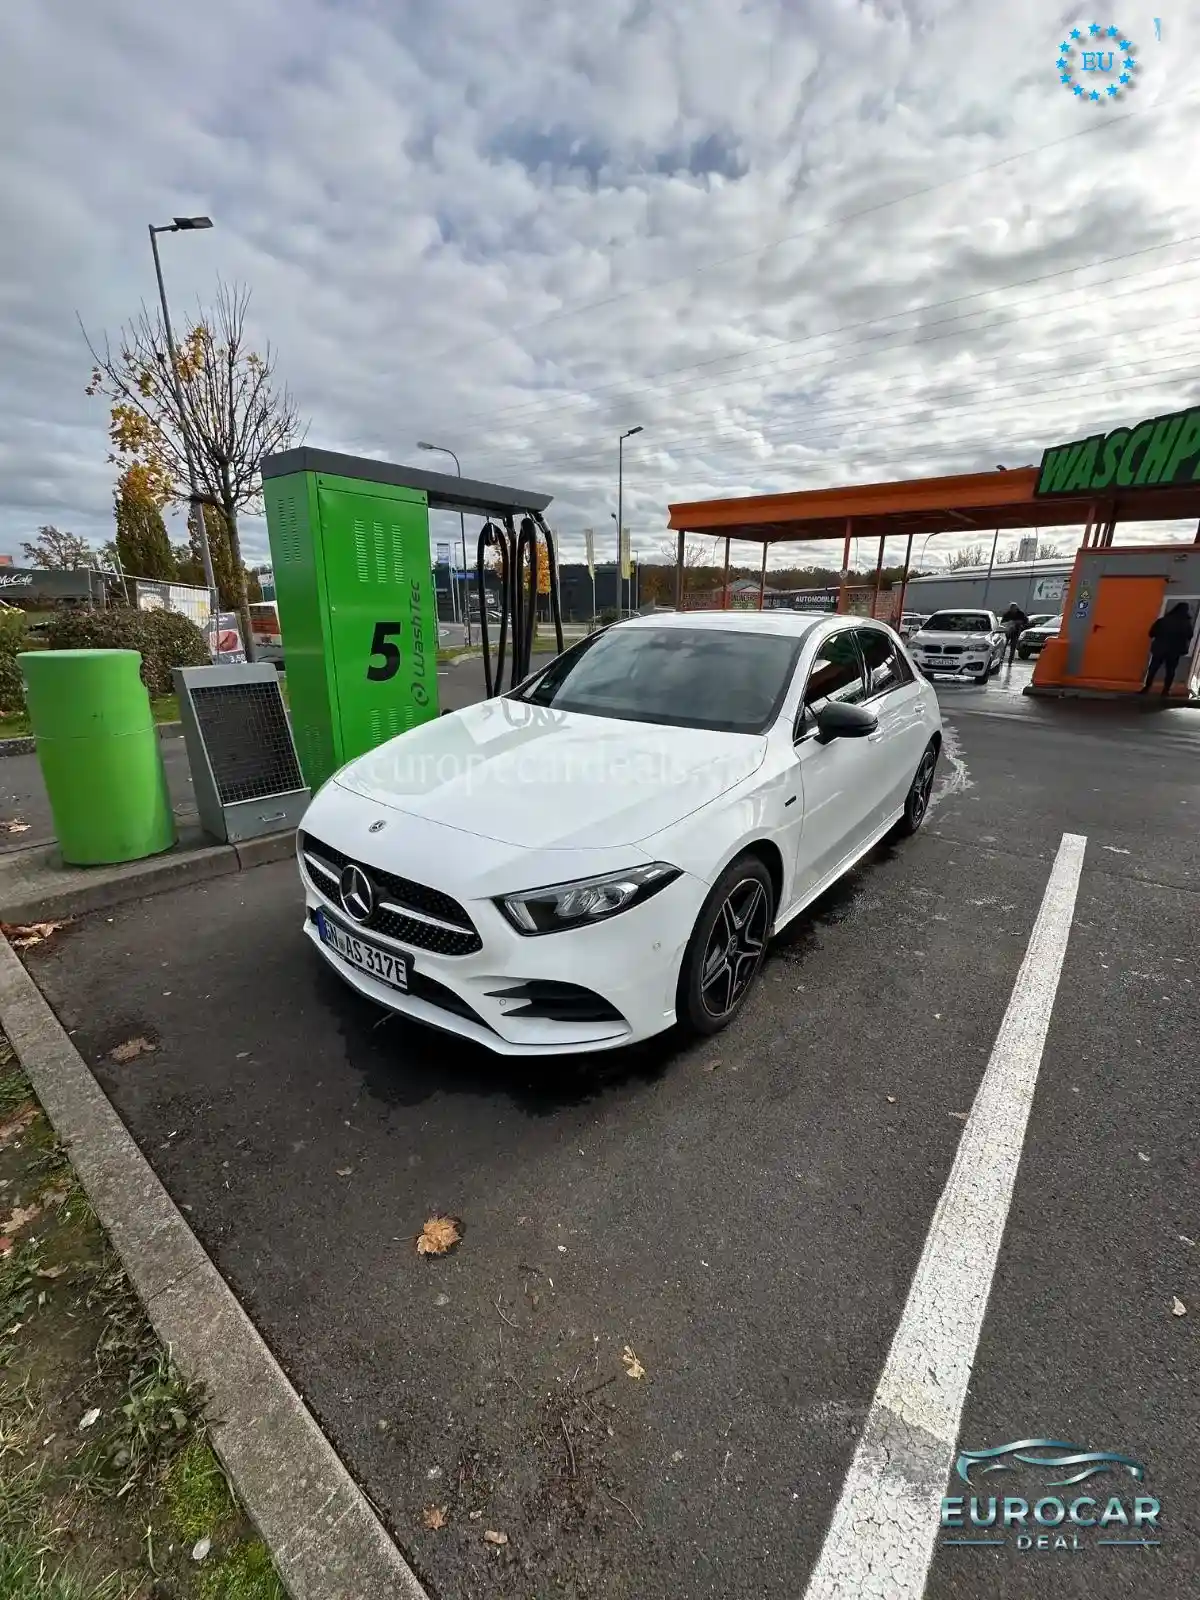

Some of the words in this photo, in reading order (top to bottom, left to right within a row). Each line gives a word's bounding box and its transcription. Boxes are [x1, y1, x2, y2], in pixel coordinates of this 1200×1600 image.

[1038, 412, 1200, 493] WASCHP
[409, 579, 426, 678] WashTec
[795, 595, 836, 603] AUTOMOBILE
[366, 621, 401, 682] 5
[345, 936, 363, 964] AS
[364, 946, 408, 985] 317E
